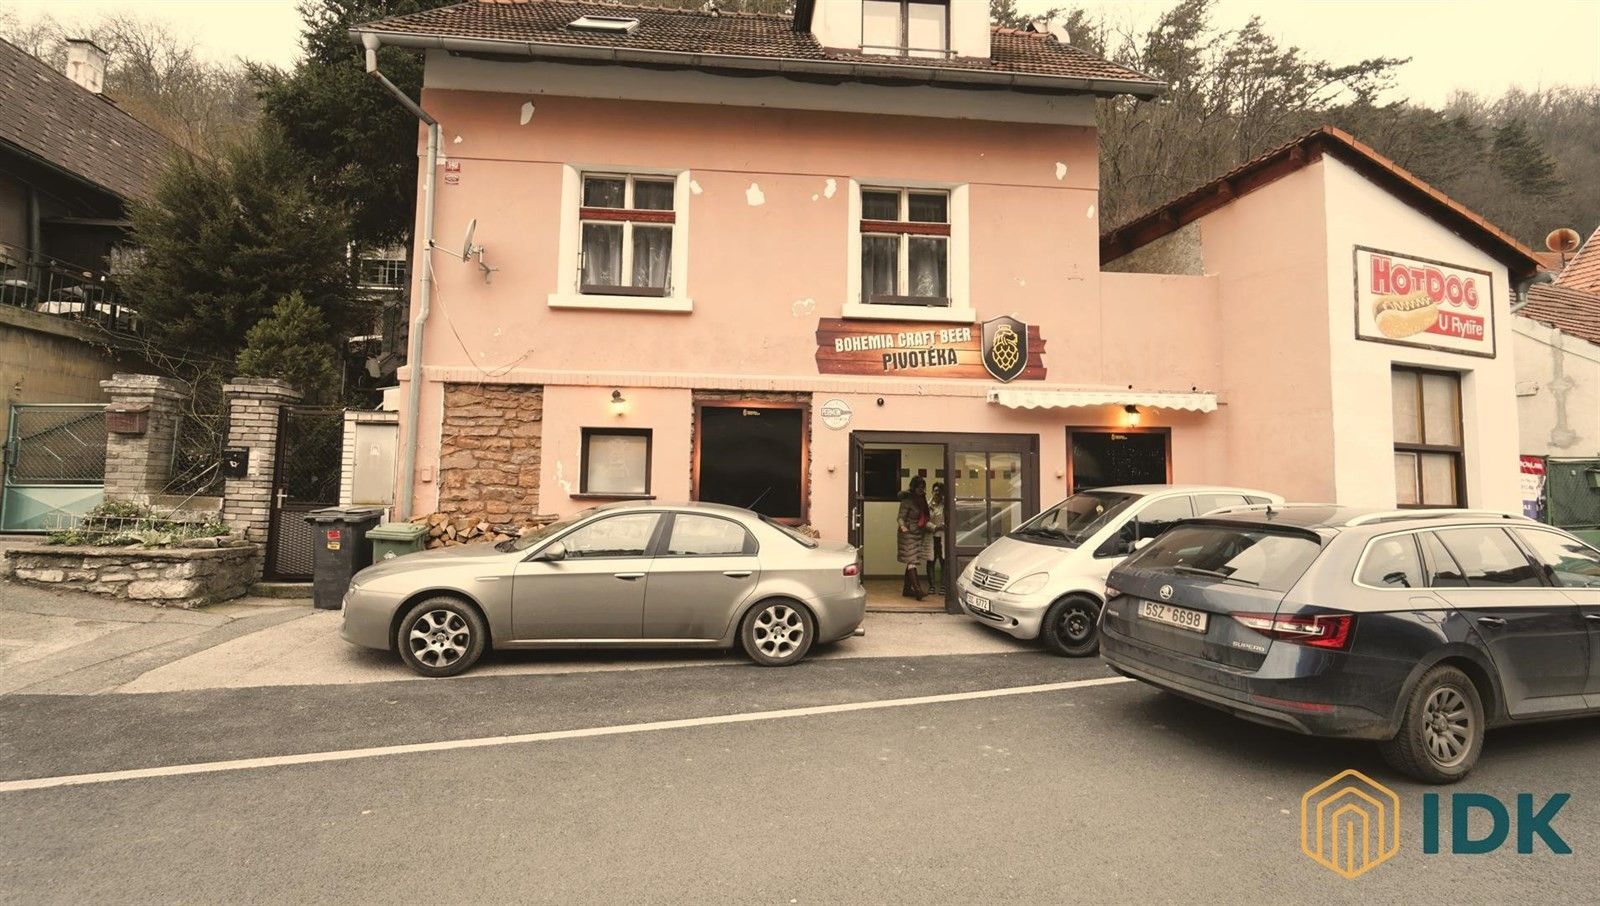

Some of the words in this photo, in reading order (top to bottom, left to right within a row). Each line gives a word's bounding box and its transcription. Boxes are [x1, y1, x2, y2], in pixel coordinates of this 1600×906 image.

[1439, 313, 1448, 331] U
[834, 333, 895, 353] BOHEMIA
[897, 330, 937, 348] CRAFT
[940, 327, 972, 343] BEER
[882, 346, 959, 371] PIVOTÉKA
[1145, 602, 1165, 619] 5SZ
[1172, 608, 1201, 628] 6698
